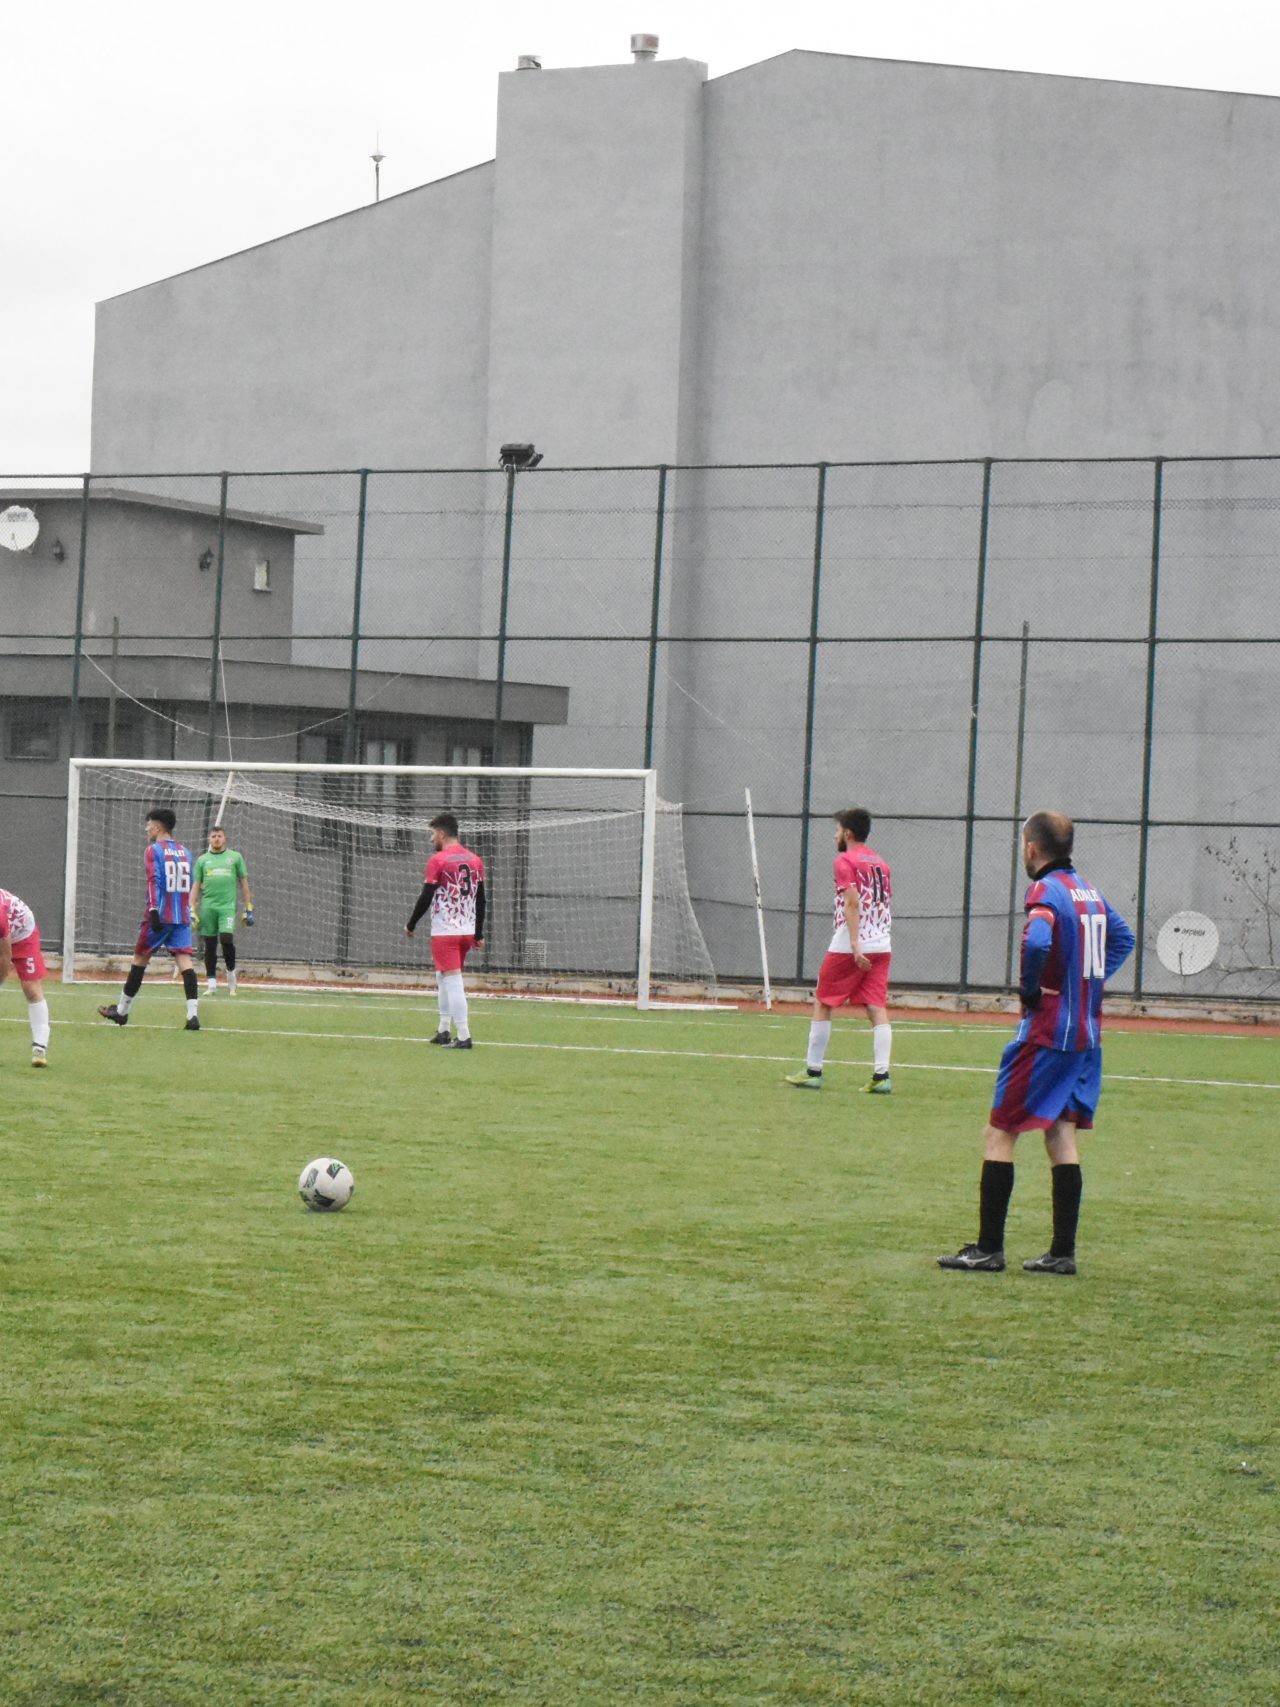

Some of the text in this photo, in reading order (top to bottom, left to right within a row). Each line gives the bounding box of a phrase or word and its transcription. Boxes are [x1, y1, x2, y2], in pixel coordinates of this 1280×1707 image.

[164, 860, 191, 893] 86
[458, 864, 471, 896] 3
[869, 865, 885, 903] 11
[1080, 914, 1107, 980] 10
[26, 957, 36, 974] 5
